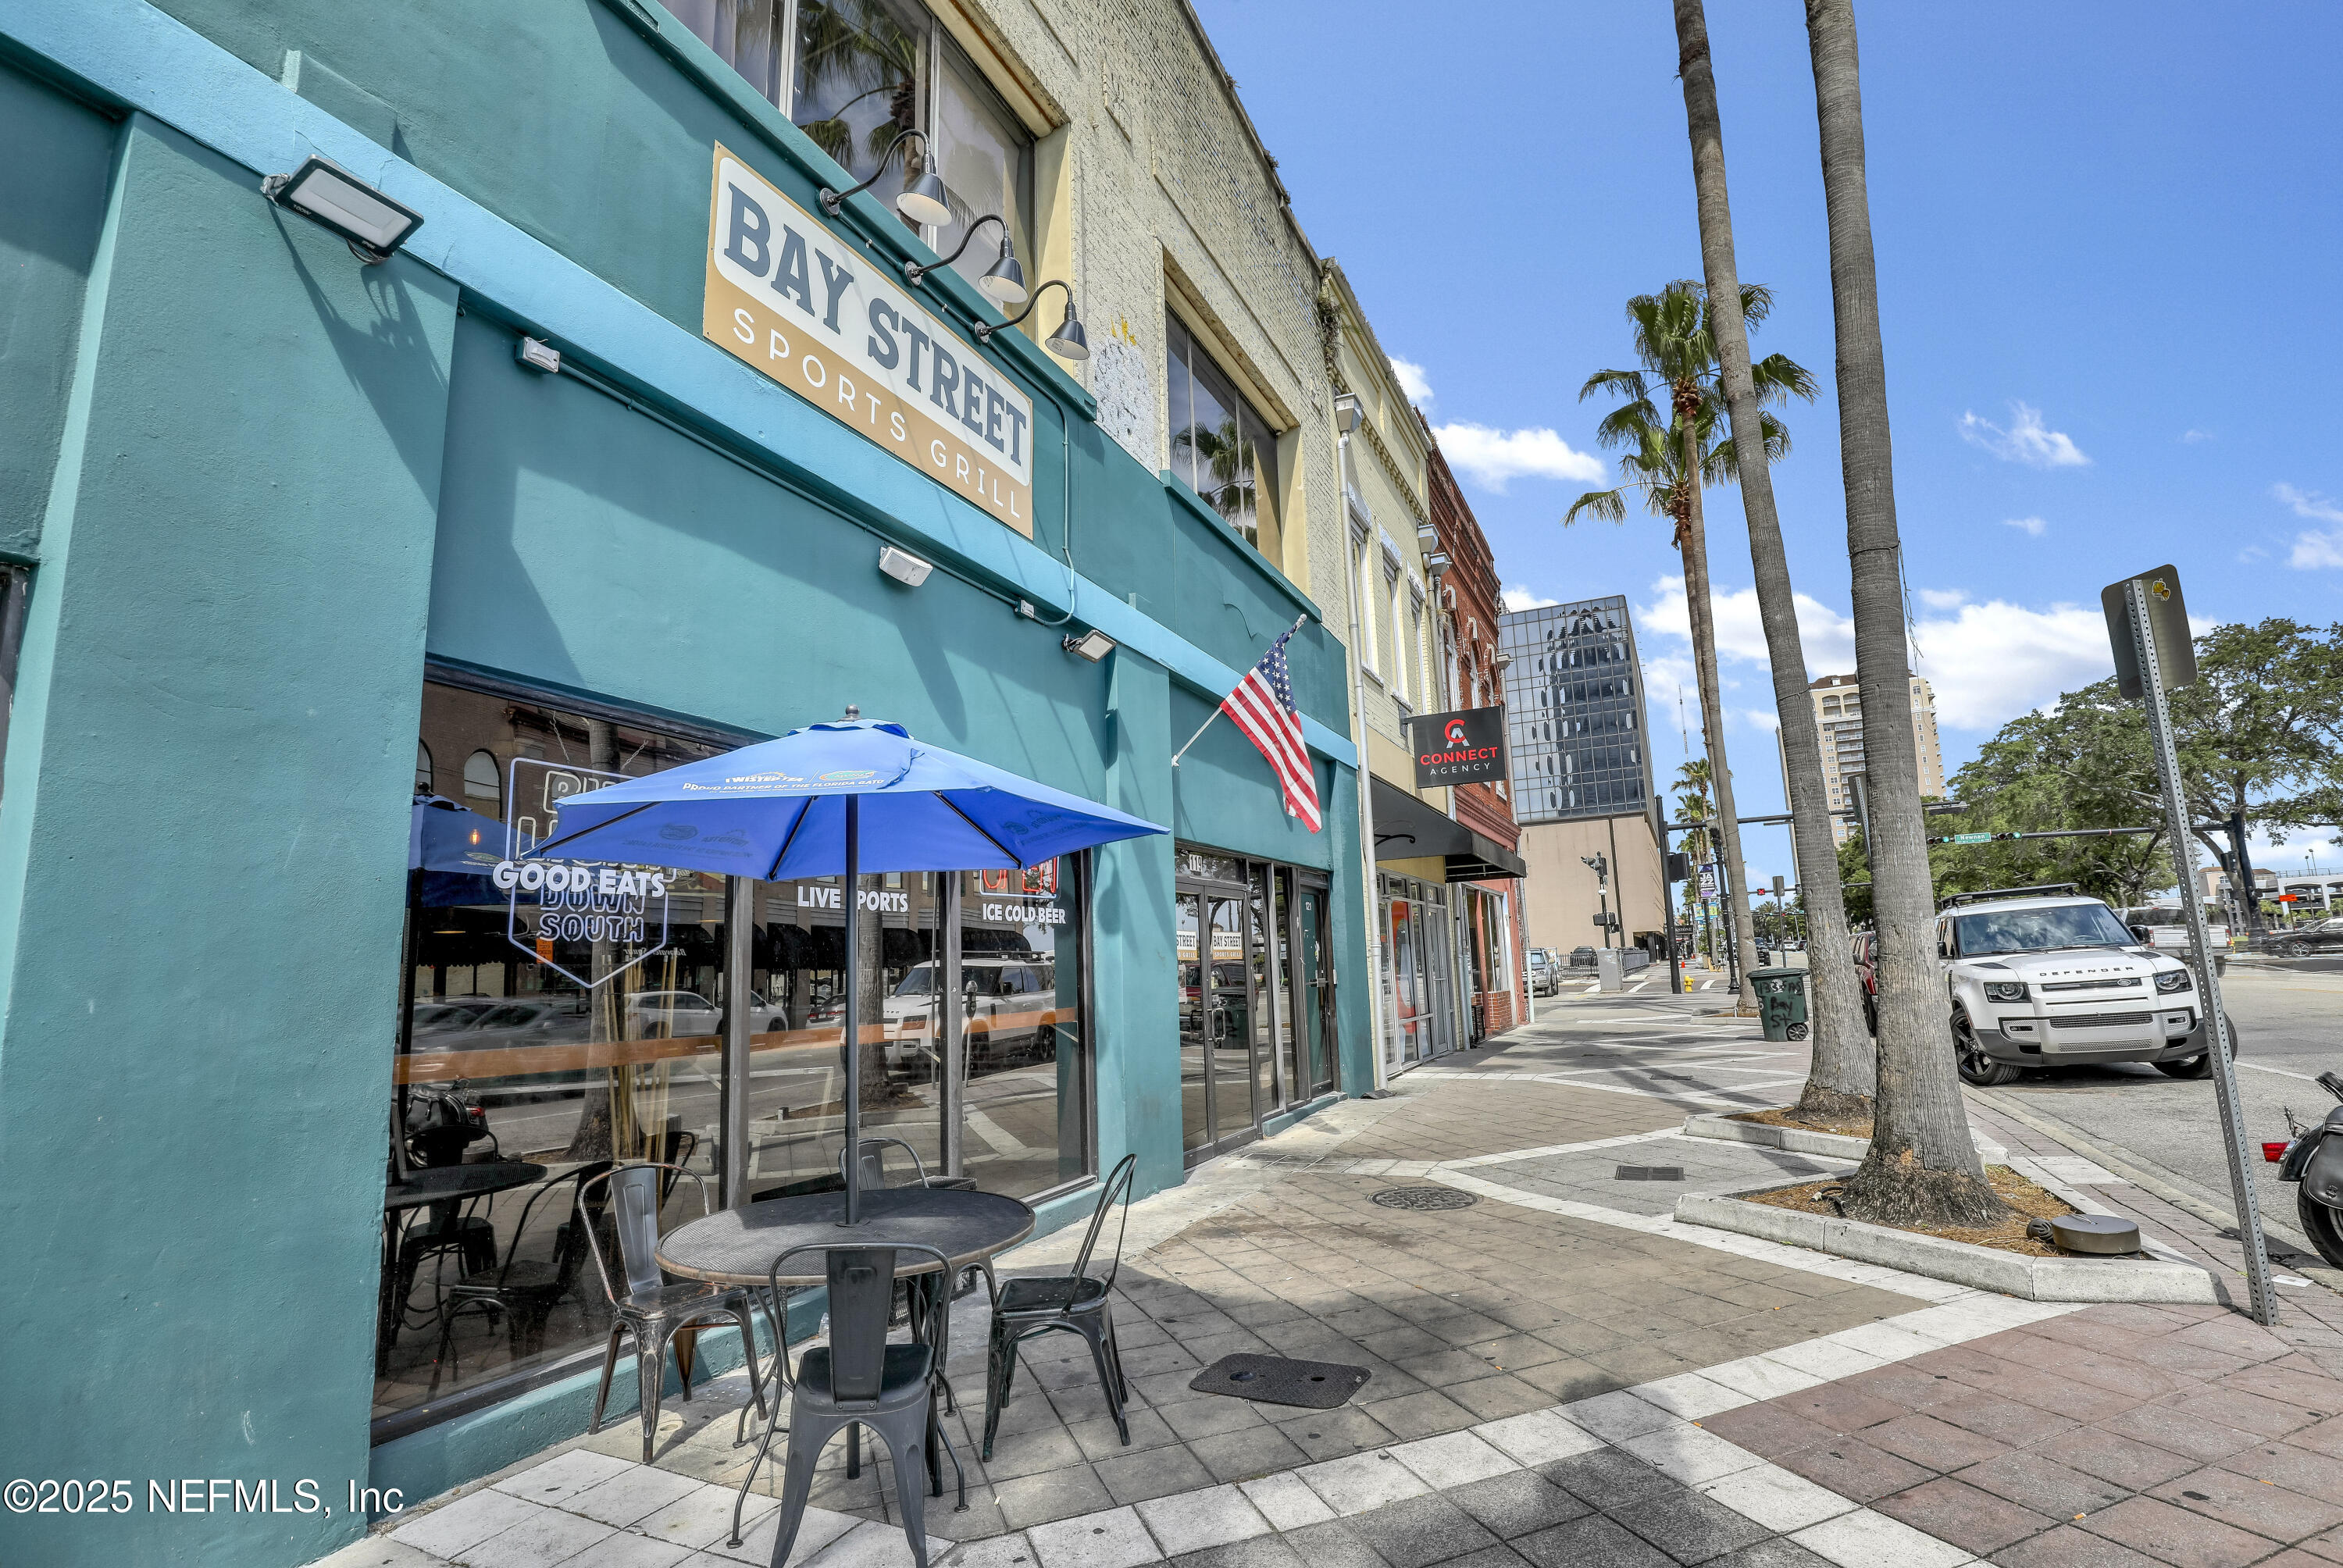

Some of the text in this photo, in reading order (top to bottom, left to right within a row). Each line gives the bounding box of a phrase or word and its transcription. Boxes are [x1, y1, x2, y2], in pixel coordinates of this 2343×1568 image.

[723, 180, 1026, 467] BAY STREET
[733, 308, 1020, 519] SPORTS GRILL
[1420, 747, 1498, 765] CONNECT
[1430, 762, 1490, 775] AGENCY
[682, 782, 722, 791] PROUD
[1190, 855, 1202, 871] 119
[492, 861, 665, 897] GOOD EATS
[540, 882, 646, 914] DOWN
[797, 886, 908, 913] LIVE PORTS
[982, 903, 1066, 925] ICE COLD BEER
[539, 913, 644, 943] SOUTH
[1213, 935, 1241, 947] BAY STREET
[2039, 966, 2134, 977] DEFENDER
[1770, 996, 1793, 1016] Bay
